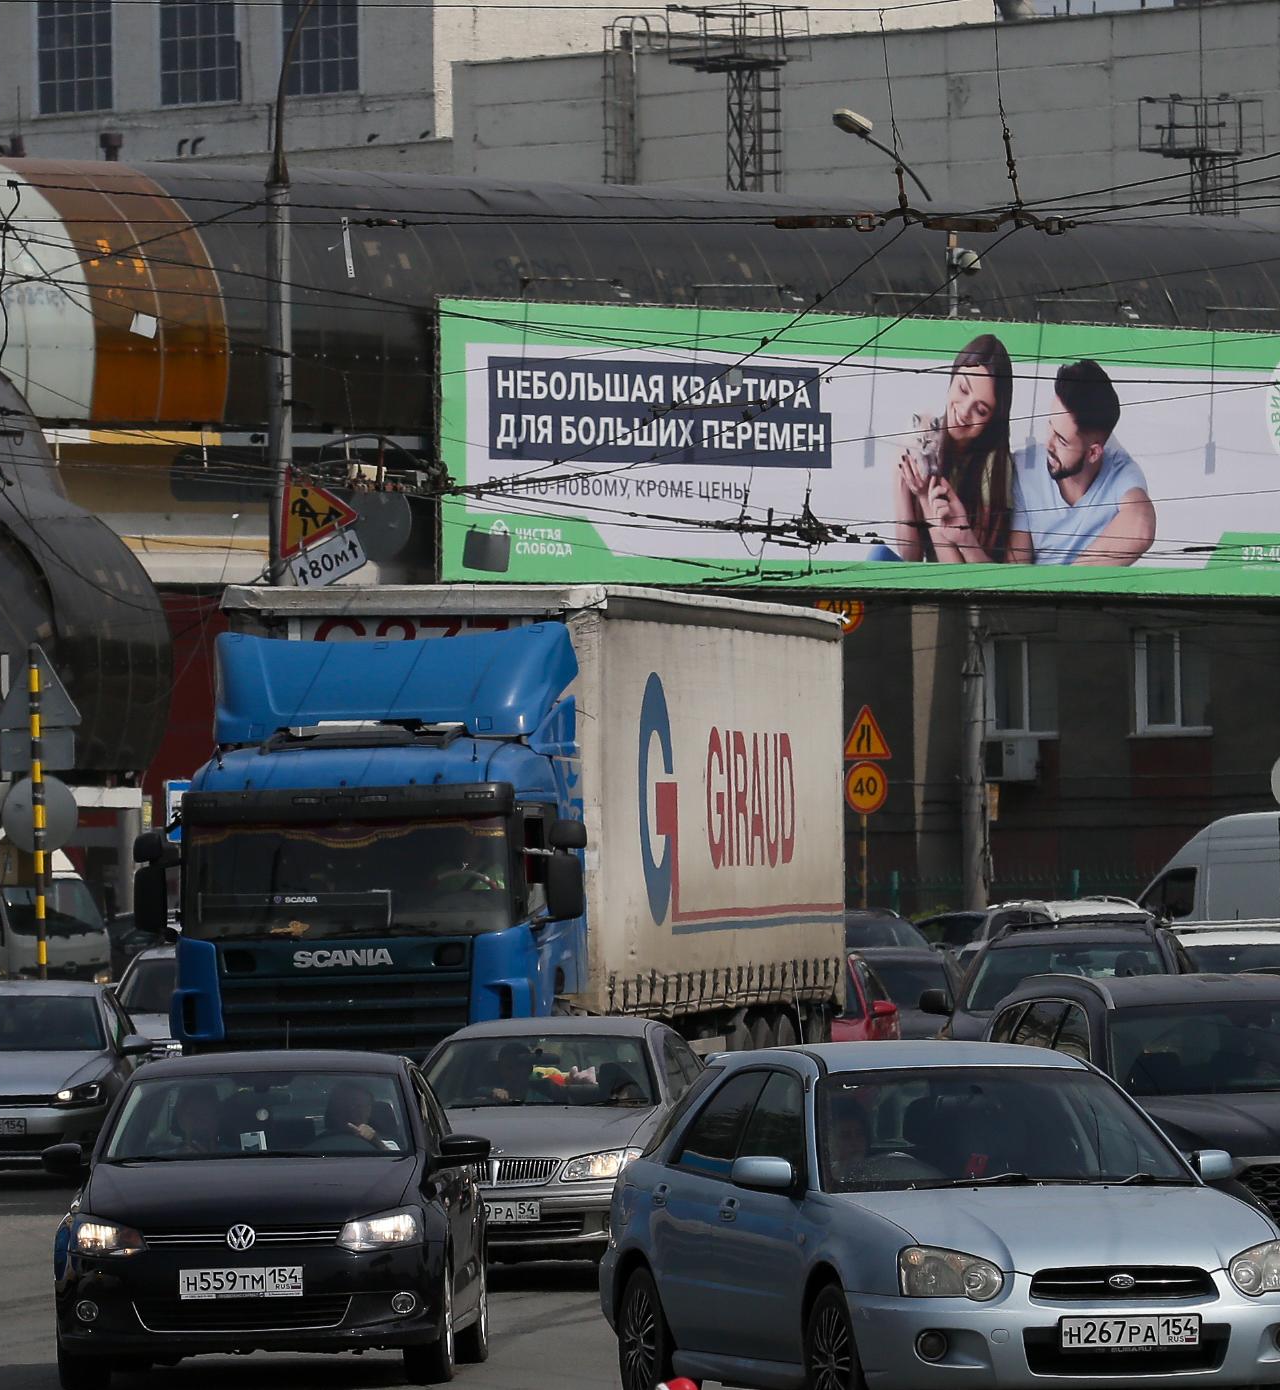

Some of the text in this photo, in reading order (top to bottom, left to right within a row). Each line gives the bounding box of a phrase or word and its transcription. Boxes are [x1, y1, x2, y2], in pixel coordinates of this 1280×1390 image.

[497, 369, 812, 409] НЕБОЛЬШАЯ КВАРТИРА
[496, 413, 825, 453] ДЛЯ БОЛЬШИХ ПЕРЕМЕН
[636, 479, 693, 499] КРОМЕ
[698, 482, 748, 502] ЦЕНЫ
[515, 527, 561, 540] ЧИСТАЯ
[515, 542, 572, 557] СЛОБОДА
[853, 775, 878, 797] 40
[706, 725, 795, 870] GIRAUD
[284, 896, 318, 904] SCANIA
[292, 947, 394, 969] SCANIA
[268, 1268, 299, 1284] 154
[1161, 1318, 1194, 1336] 154
[1167, 1335, 1185, 1343] RUS
